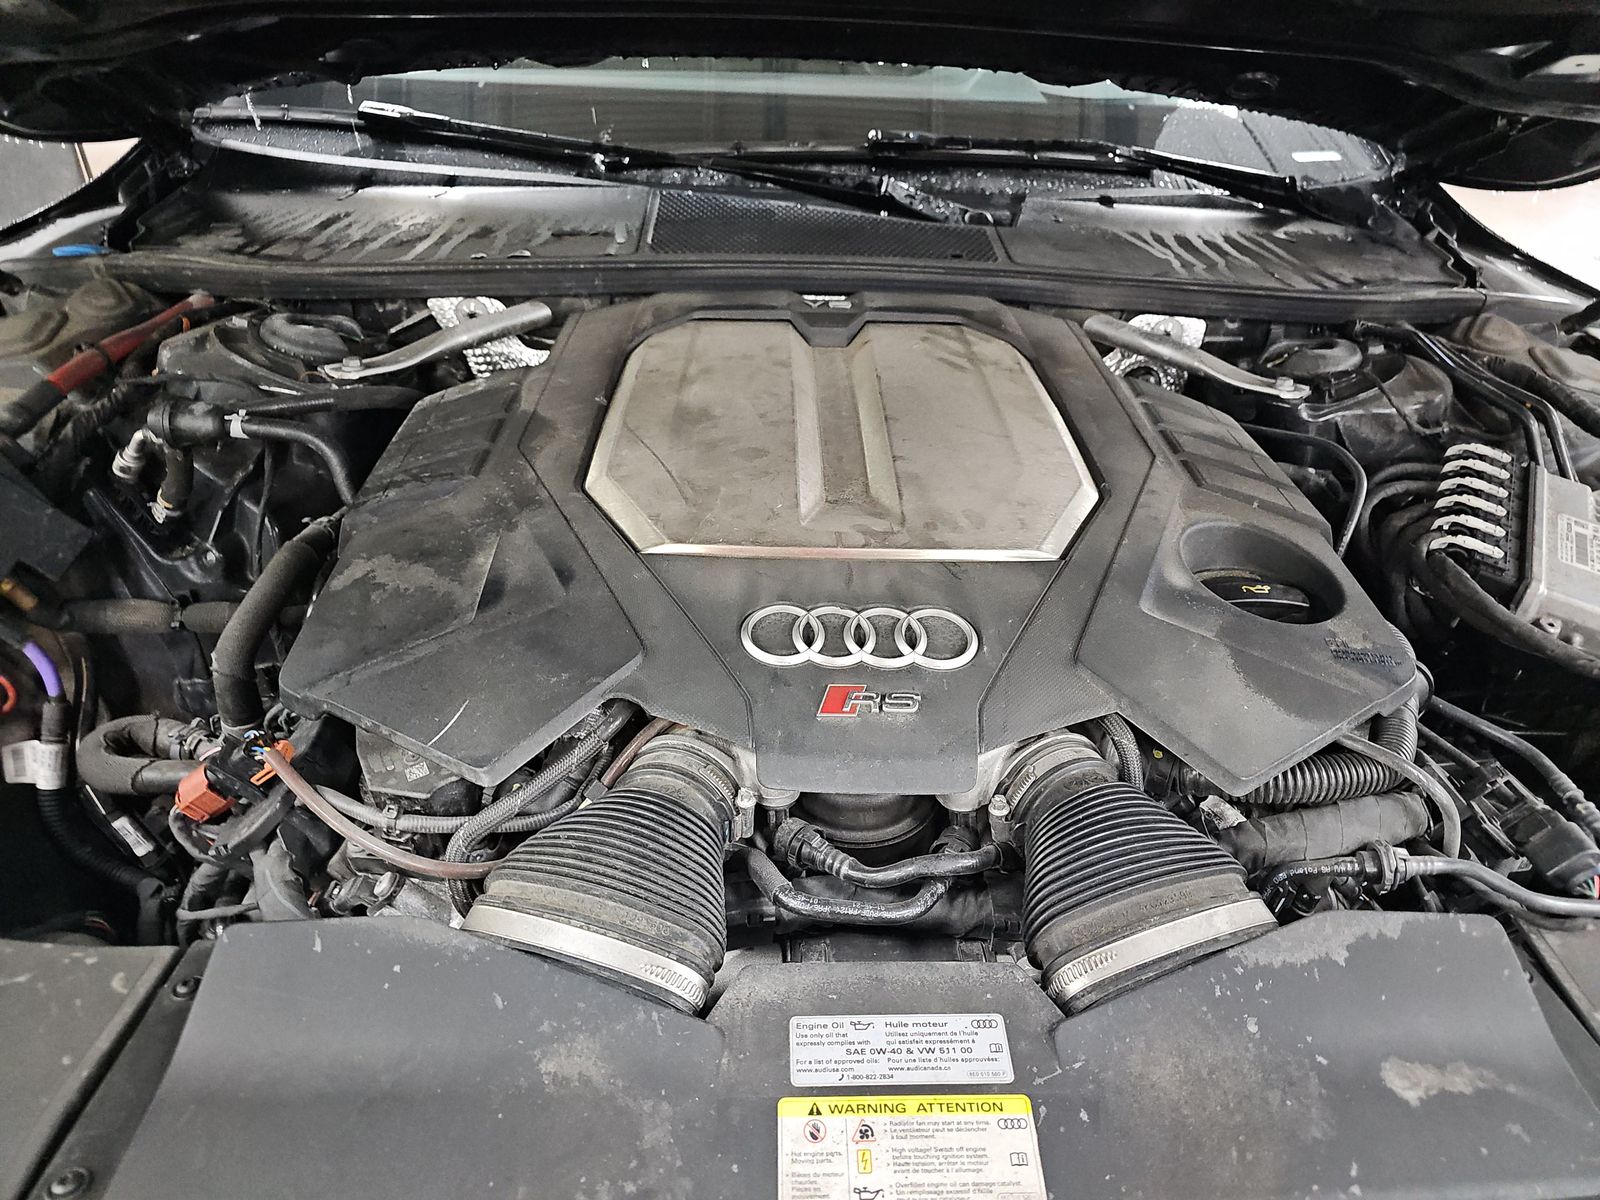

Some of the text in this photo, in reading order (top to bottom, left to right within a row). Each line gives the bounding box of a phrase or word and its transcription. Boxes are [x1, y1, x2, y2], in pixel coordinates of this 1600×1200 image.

[837, 689, 921, 714] RS
[796, 1022, 828, 1031] Engine
[828, 1102, 1004, 1114] WARNING ATTENTION
